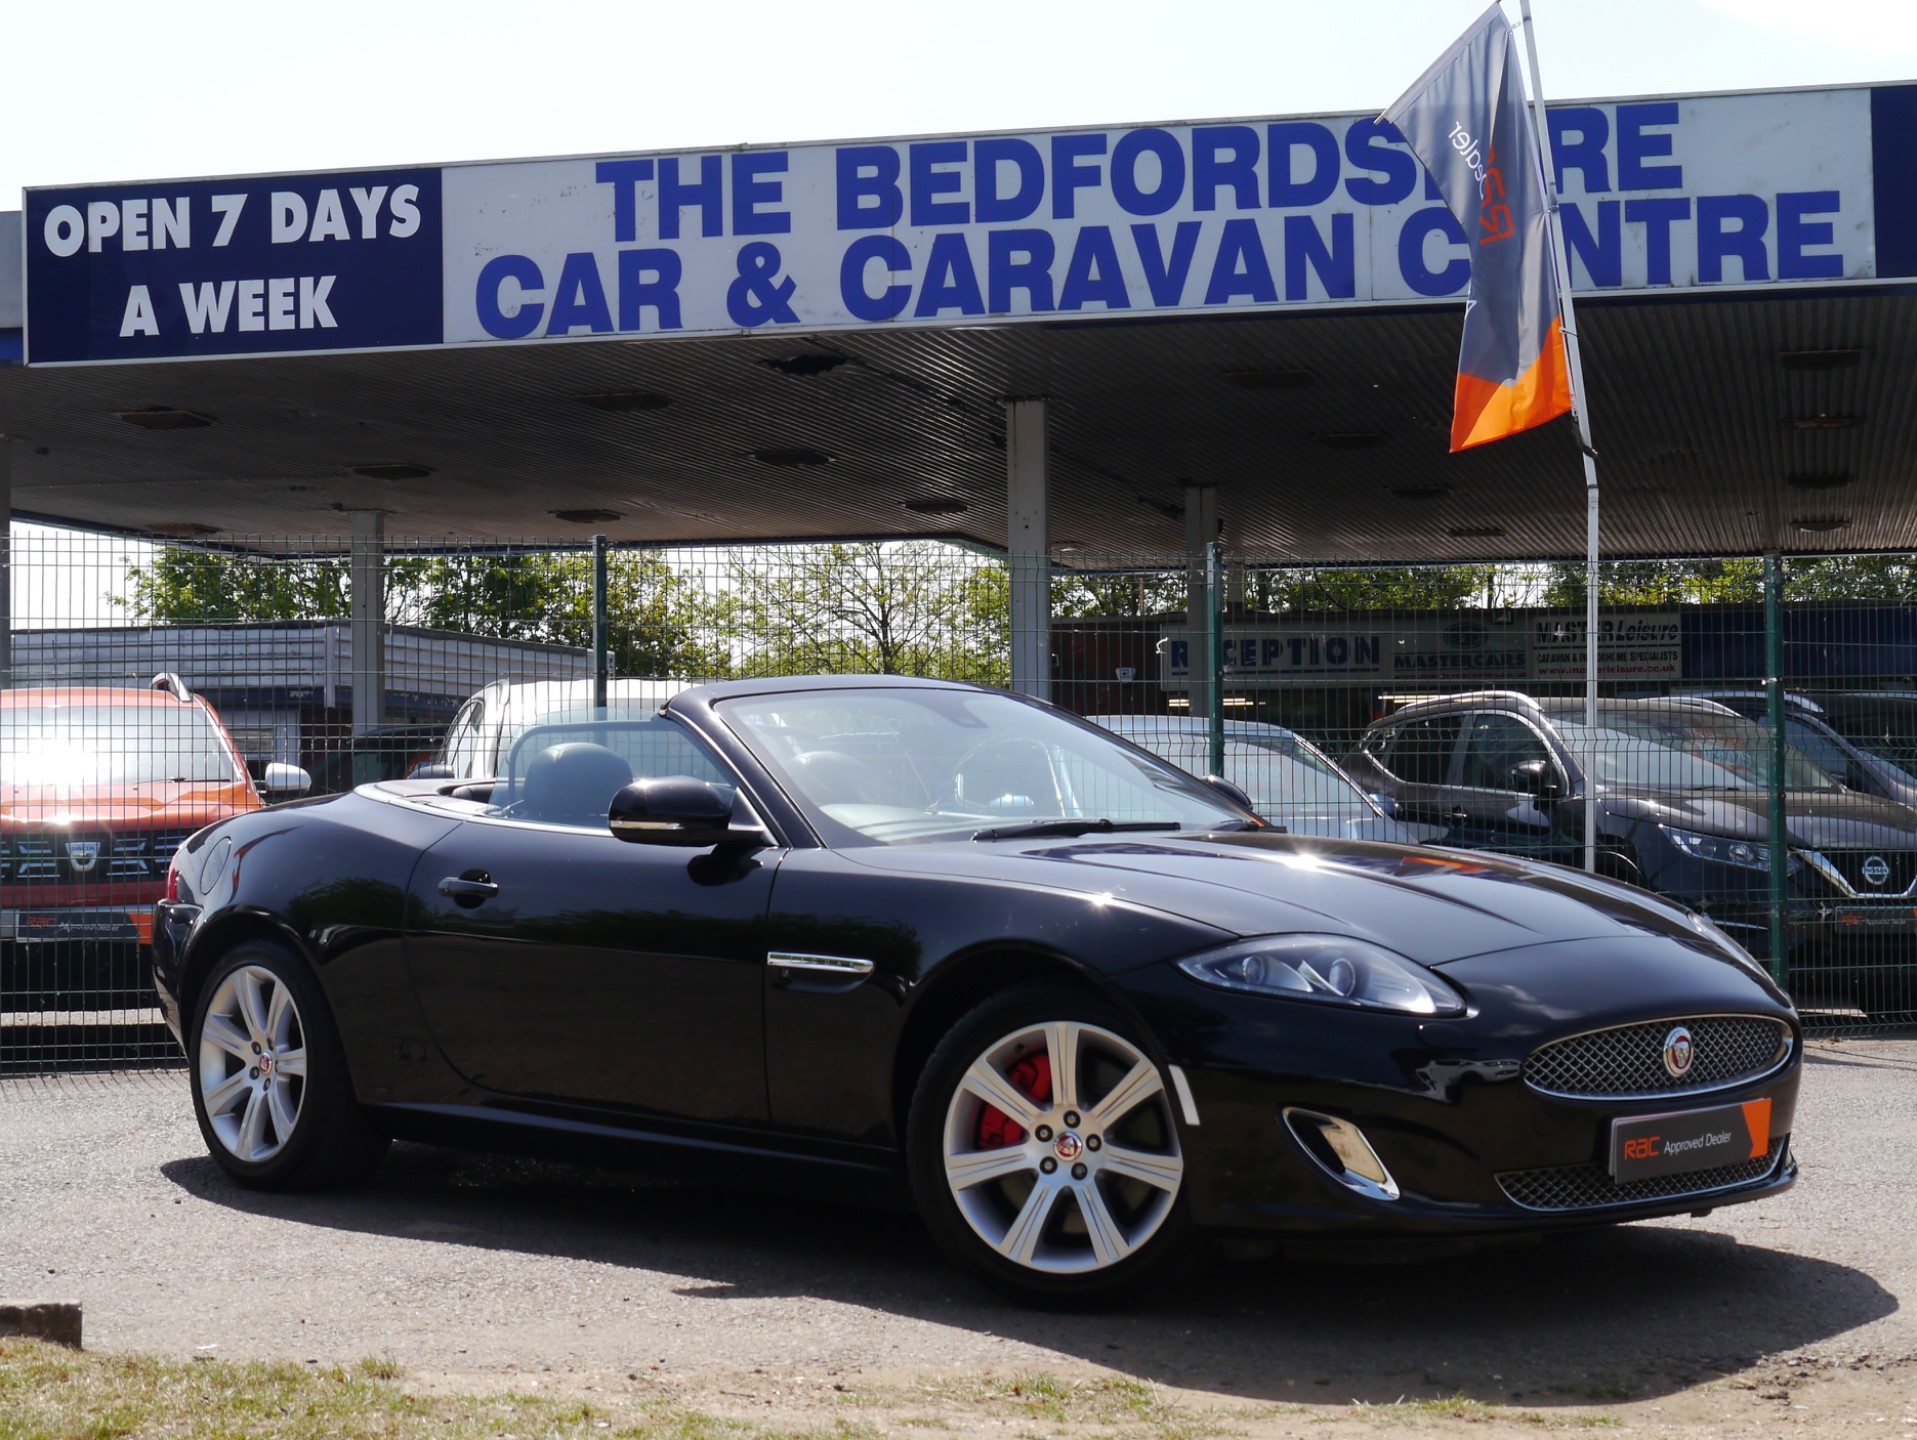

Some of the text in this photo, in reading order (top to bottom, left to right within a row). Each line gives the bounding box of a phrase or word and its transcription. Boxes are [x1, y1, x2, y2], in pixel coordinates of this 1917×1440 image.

[595, 102, 1683, 242] THE BEDFORDSRE
[44, 184, 421, 257] OPEN 7 DAYS
[475, 191, 1844, 340] CAR & CARAVAN CNTRE
[120, 275, 338, 337] A WEEK
[1171, 636, 1380, 668] RCEPTION
[1539, 664, 1676, 675] www.maerleisure.co.uk
[1579, 651, 1628, 663] MORHOME
[1664, 1134, 1705, 1157] Approved
[1705, 1131, 1732, 1146] Dealer
